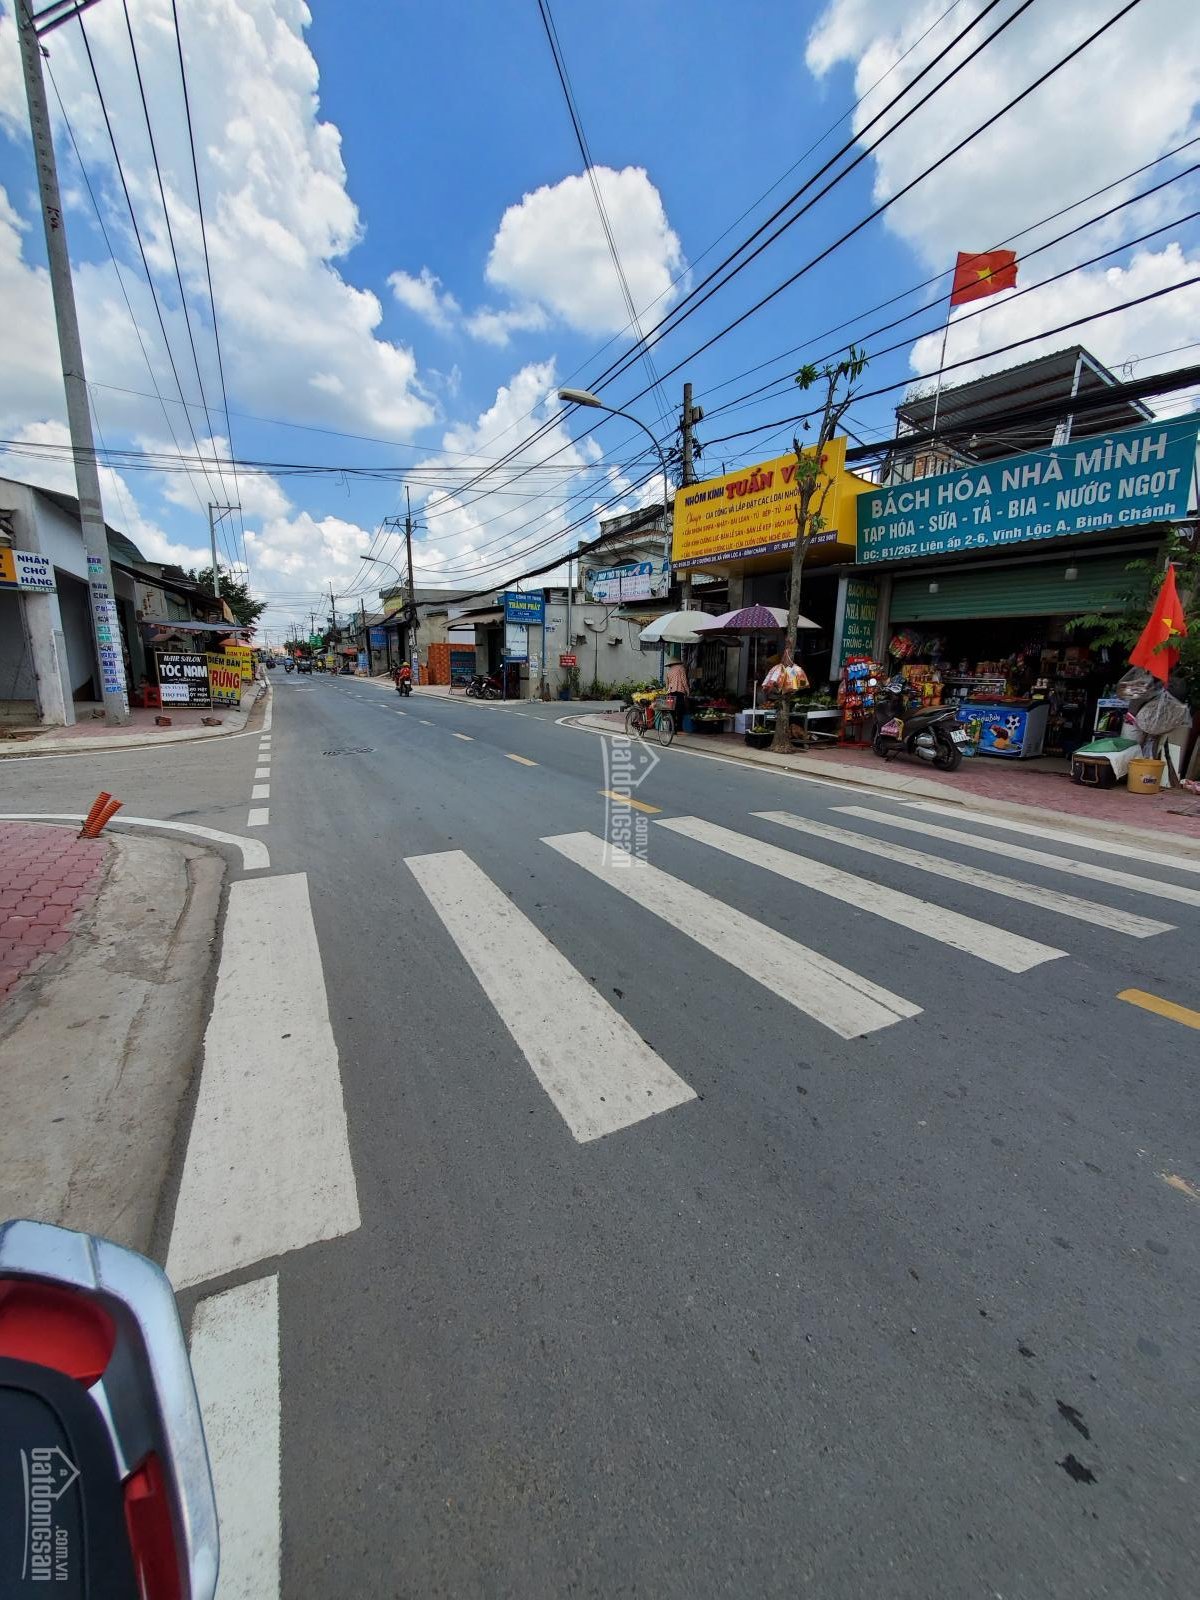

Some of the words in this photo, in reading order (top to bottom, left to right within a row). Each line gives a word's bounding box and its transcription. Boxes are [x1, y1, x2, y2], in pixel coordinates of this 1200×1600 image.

[726, 467, 774, 499] TUẤN
[872, 488, 929, 519] BÁCH
[938, 473, 992, 506] HÓA
[1002, 453, 1063, 492] NHÀ
[1074, 433, 1168, 477] MÌNH
[863, 525, 885, 546] TẠP
[890, 518, 915, 539] HÓA
[928, 510, 958, 533] SỮA
[972, 500, 992, 525] TẢ
[1008, 496, 1037, 519] BIA
[1056, 480, 1112, 511] NƯỚC
[1117, 468, 1181, 499] NGỌT
[864, 551, 879, 561] ĐC:
[882, 544, 917, 558] B1/26Z
[920, 540, 944, 552] Liên
[947, 535, 962, 550] ấp
[993, 527, 1022, 541] Vĩnh
[1026, 523, 1051, 537] Lộc
[1076, 513, 1113, 529] Bình
[1118, 503, 1176, 521] Chánh
[21, 576, 53, 586] HÀNG
[160, 662, 181, 677] TÓC
[184, 665, 208, 678] NAM
